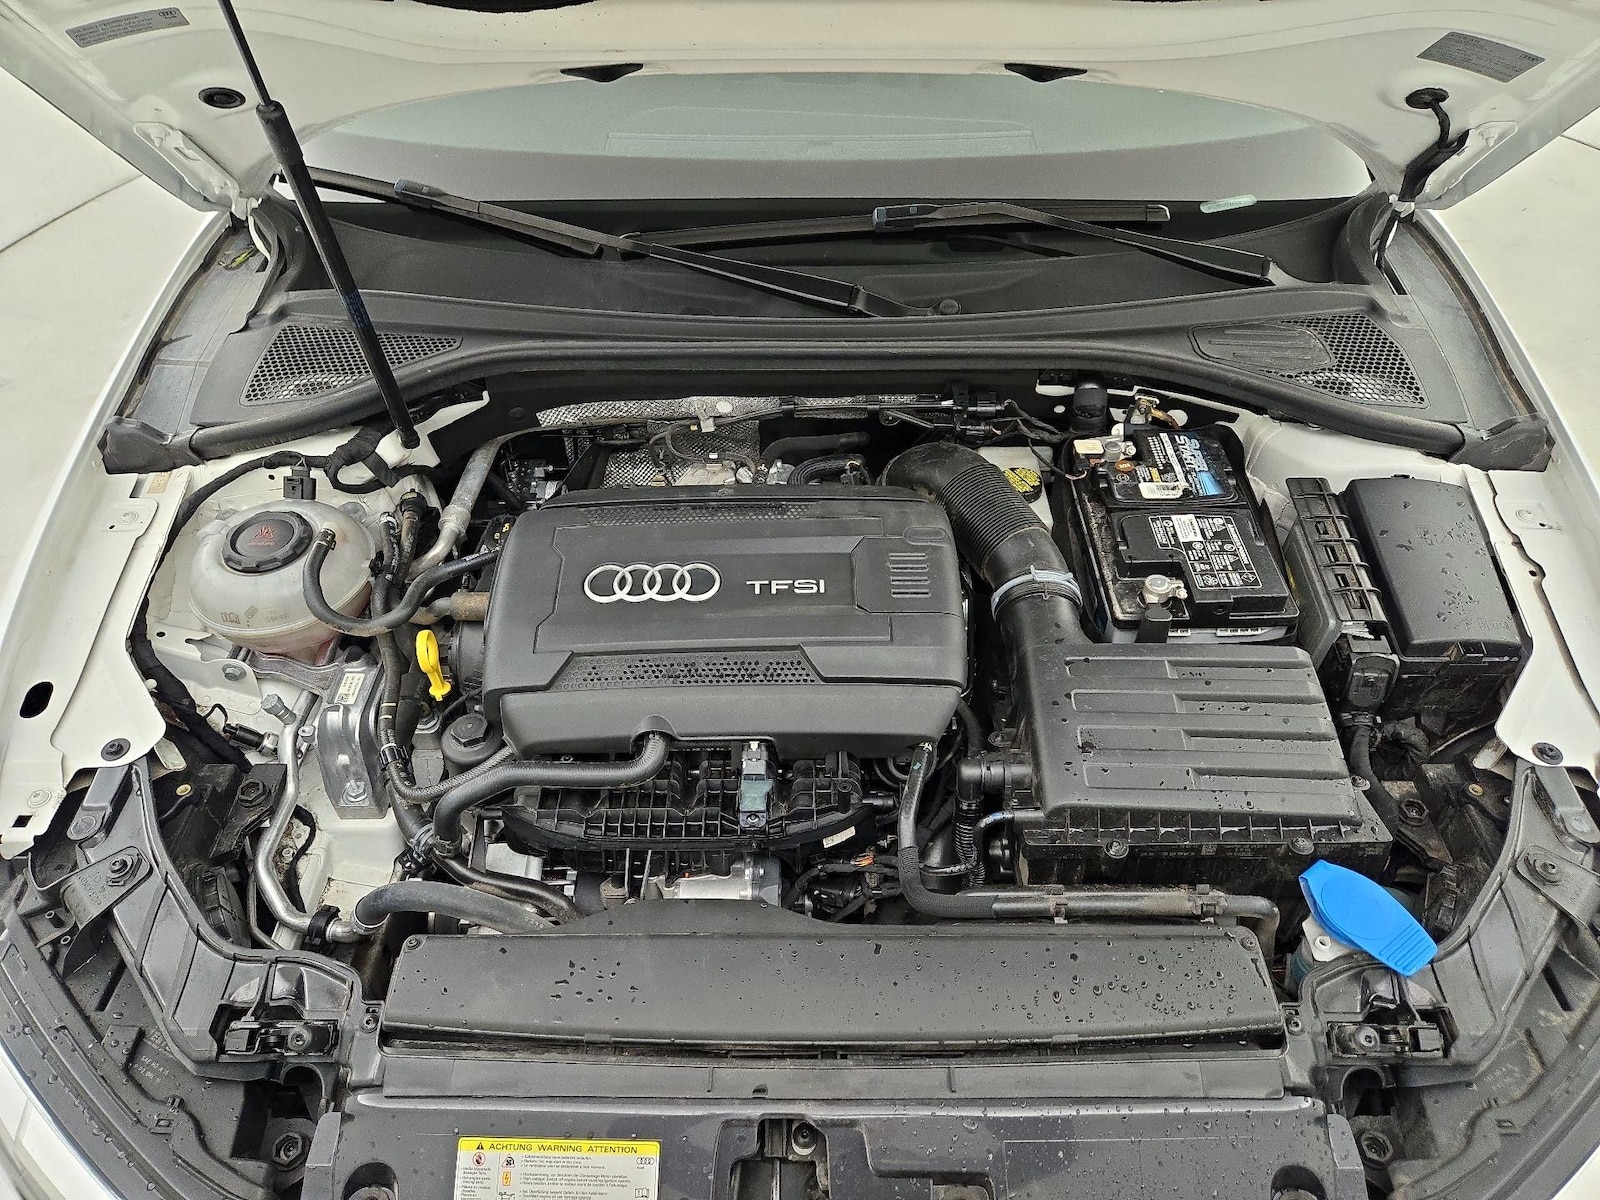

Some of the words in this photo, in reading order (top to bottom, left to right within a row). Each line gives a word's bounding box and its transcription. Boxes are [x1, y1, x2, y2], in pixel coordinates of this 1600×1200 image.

[1175, 435, 1194, 470] START
[1190, 438, 1208, 472] SUPER
[745, 579, 825, 595] TFSI
[489, 1143, 533, 1152] ACHTUNG
[538, 1144, 583, 1153] WARNING
[587, 1145, 638, 1154] ATTENTION
